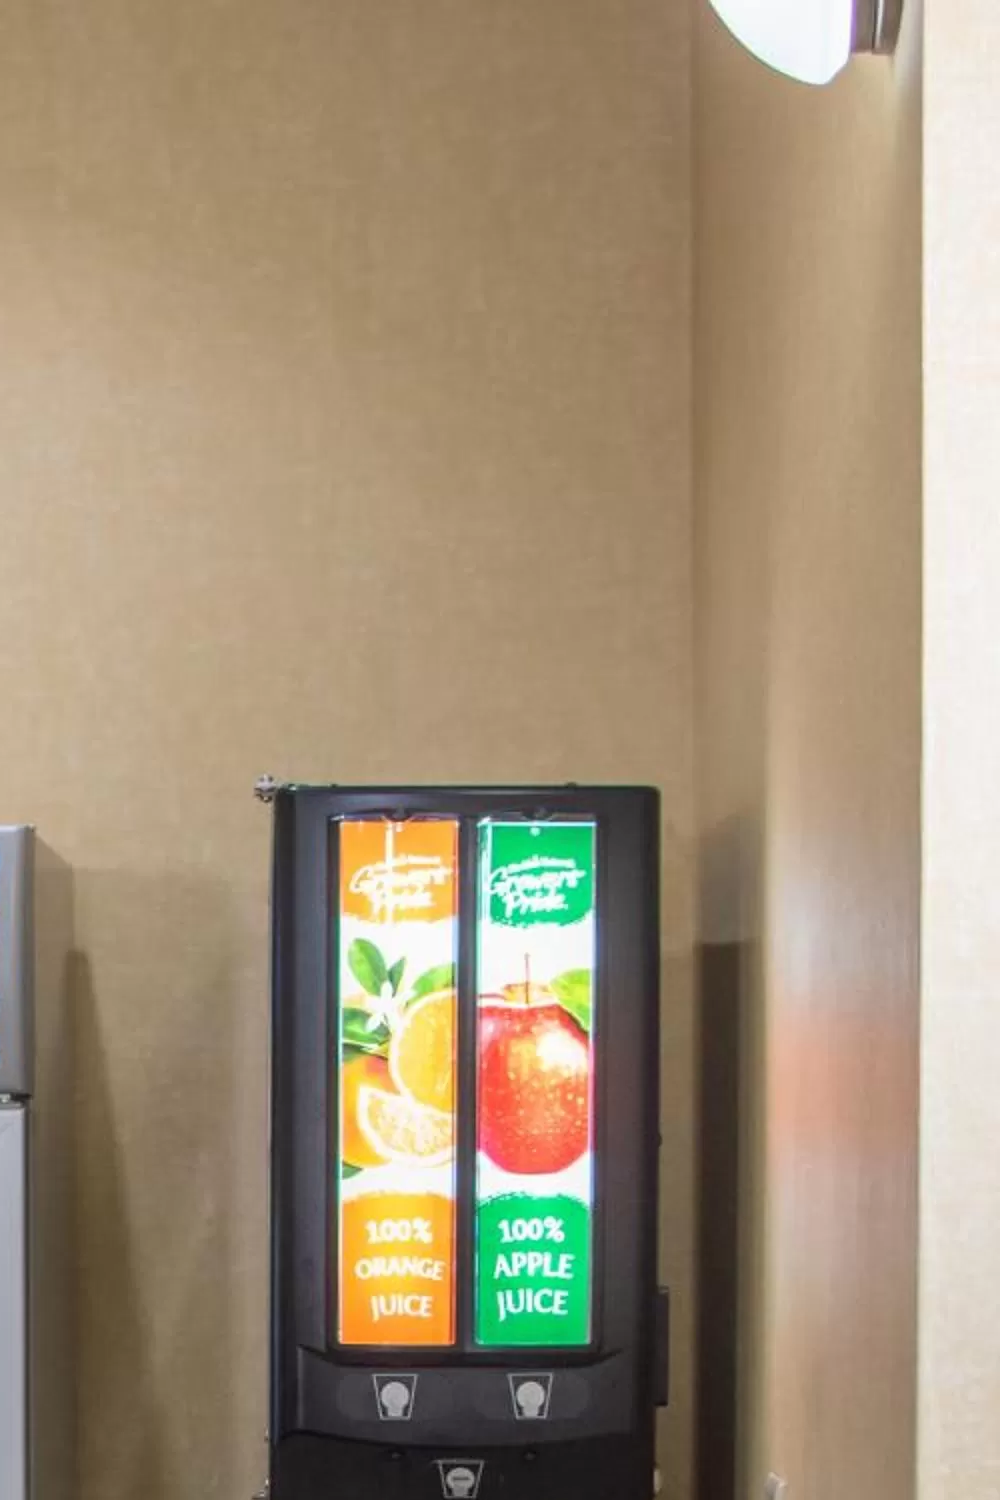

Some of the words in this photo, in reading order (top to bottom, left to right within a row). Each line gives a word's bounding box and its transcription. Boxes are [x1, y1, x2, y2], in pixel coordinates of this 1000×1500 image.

[365, 1216, 433, 1245] 100%
[497, 1216, 566, 1244] 100%
[354, 1255, 446, 1281] ORANGE
[493, 1251, 576, 1280] APPLE
[370, 1294, 433, 1323] JUICE
[496, 1287, 569, 1322] JUICE
